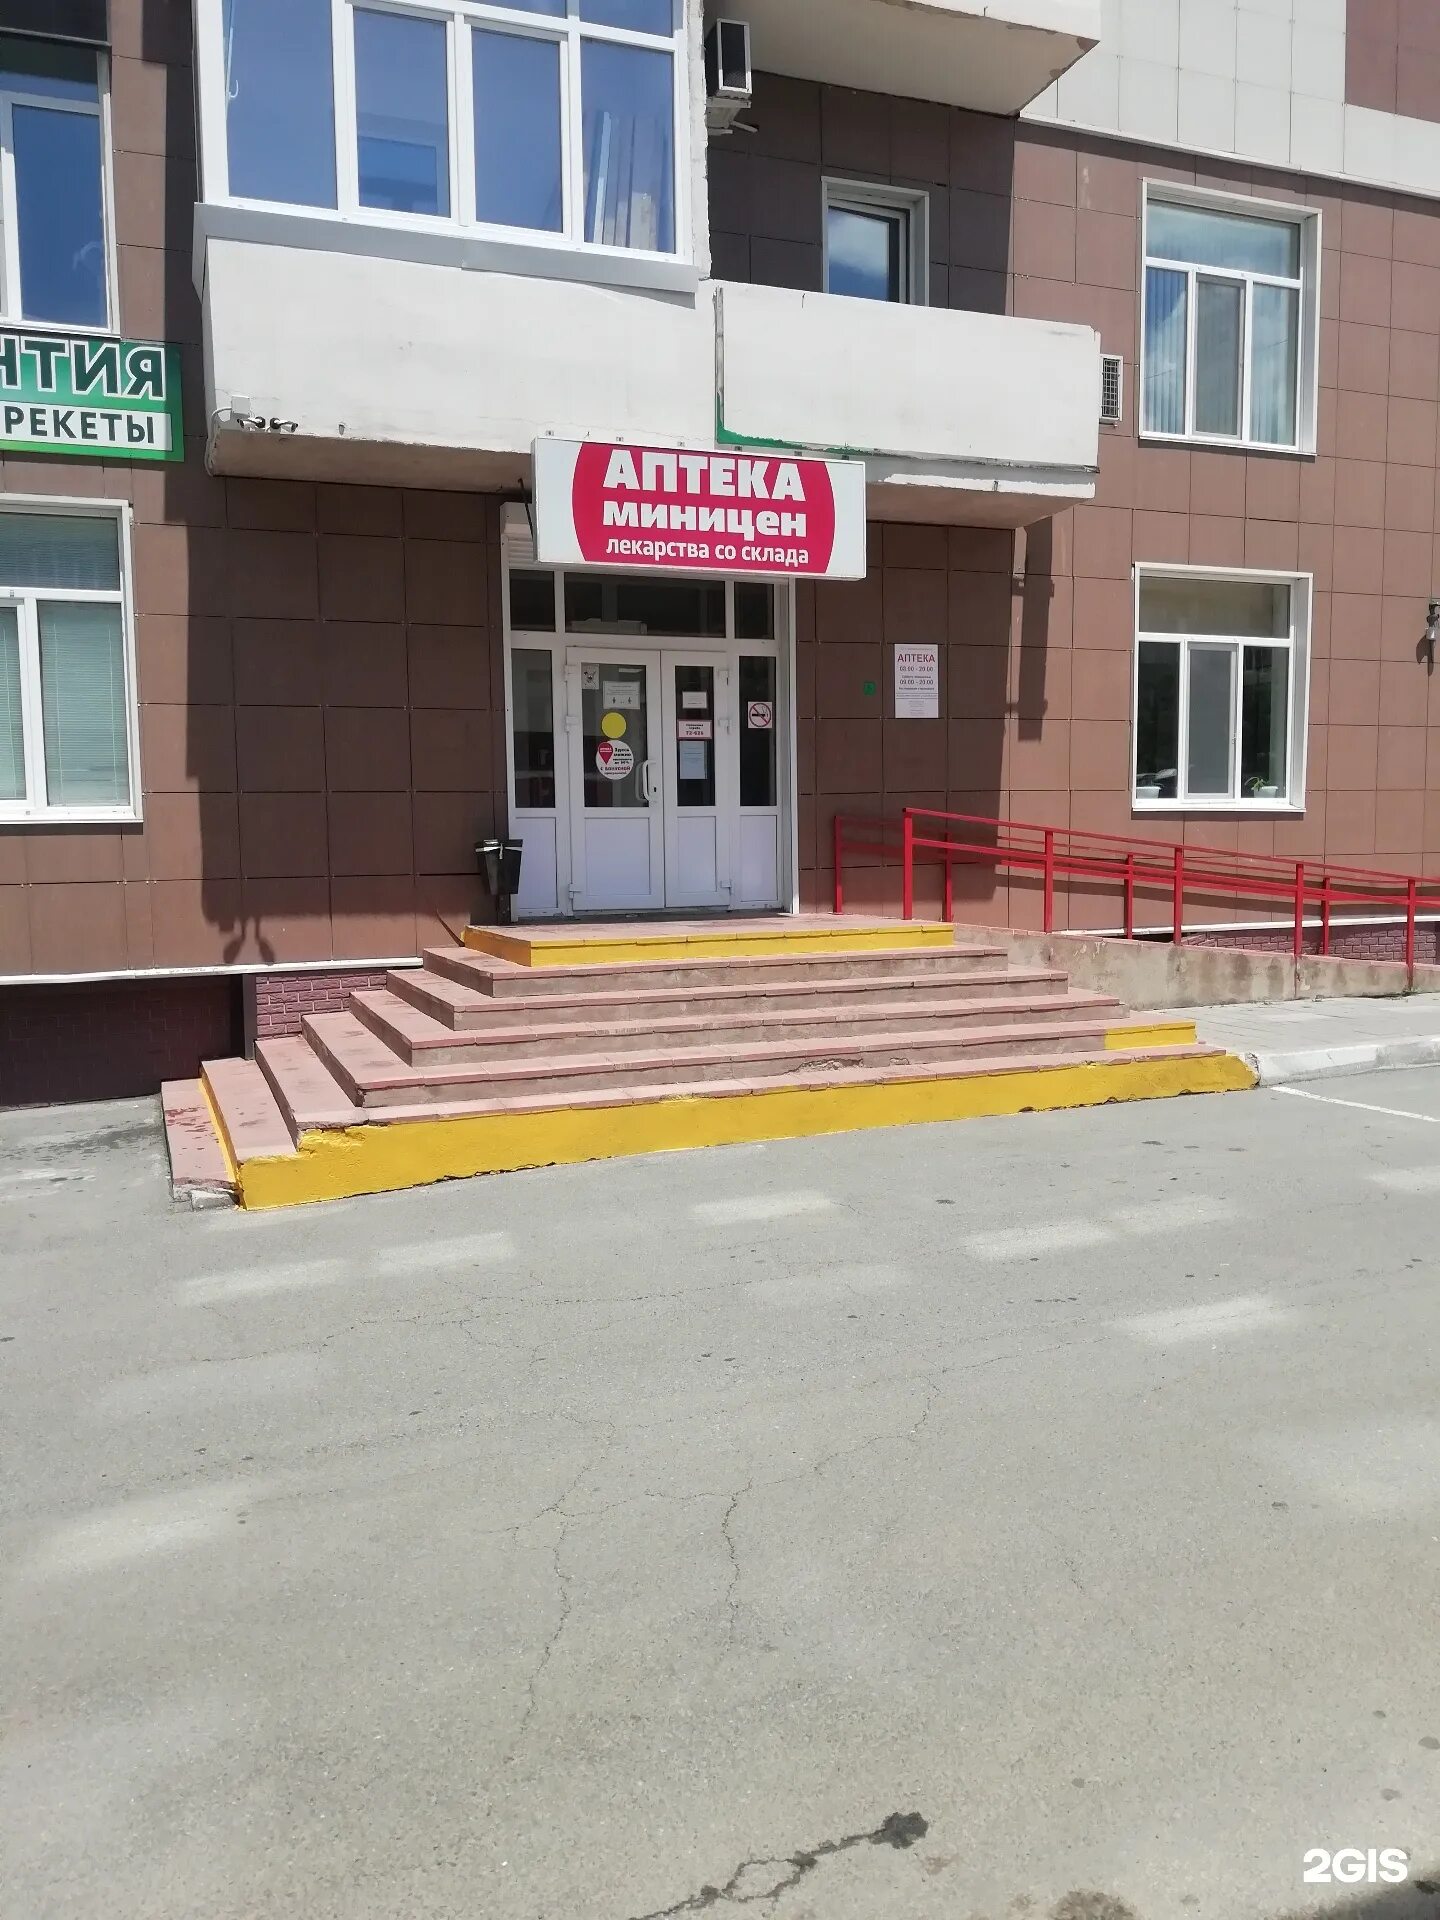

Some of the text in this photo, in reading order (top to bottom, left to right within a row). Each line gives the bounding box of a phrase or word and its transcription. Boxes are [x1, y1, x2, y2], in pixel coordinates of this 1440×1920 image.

[4, 405, 155, 444] РЕКЕТЫ
[602, 449, 806, 502] АПТЕКА
[602, 500, 807, 541] миницен
[605, 537, 809, 567] лекарства со склада
[897, 653, 936, 663] АПТЕКА
